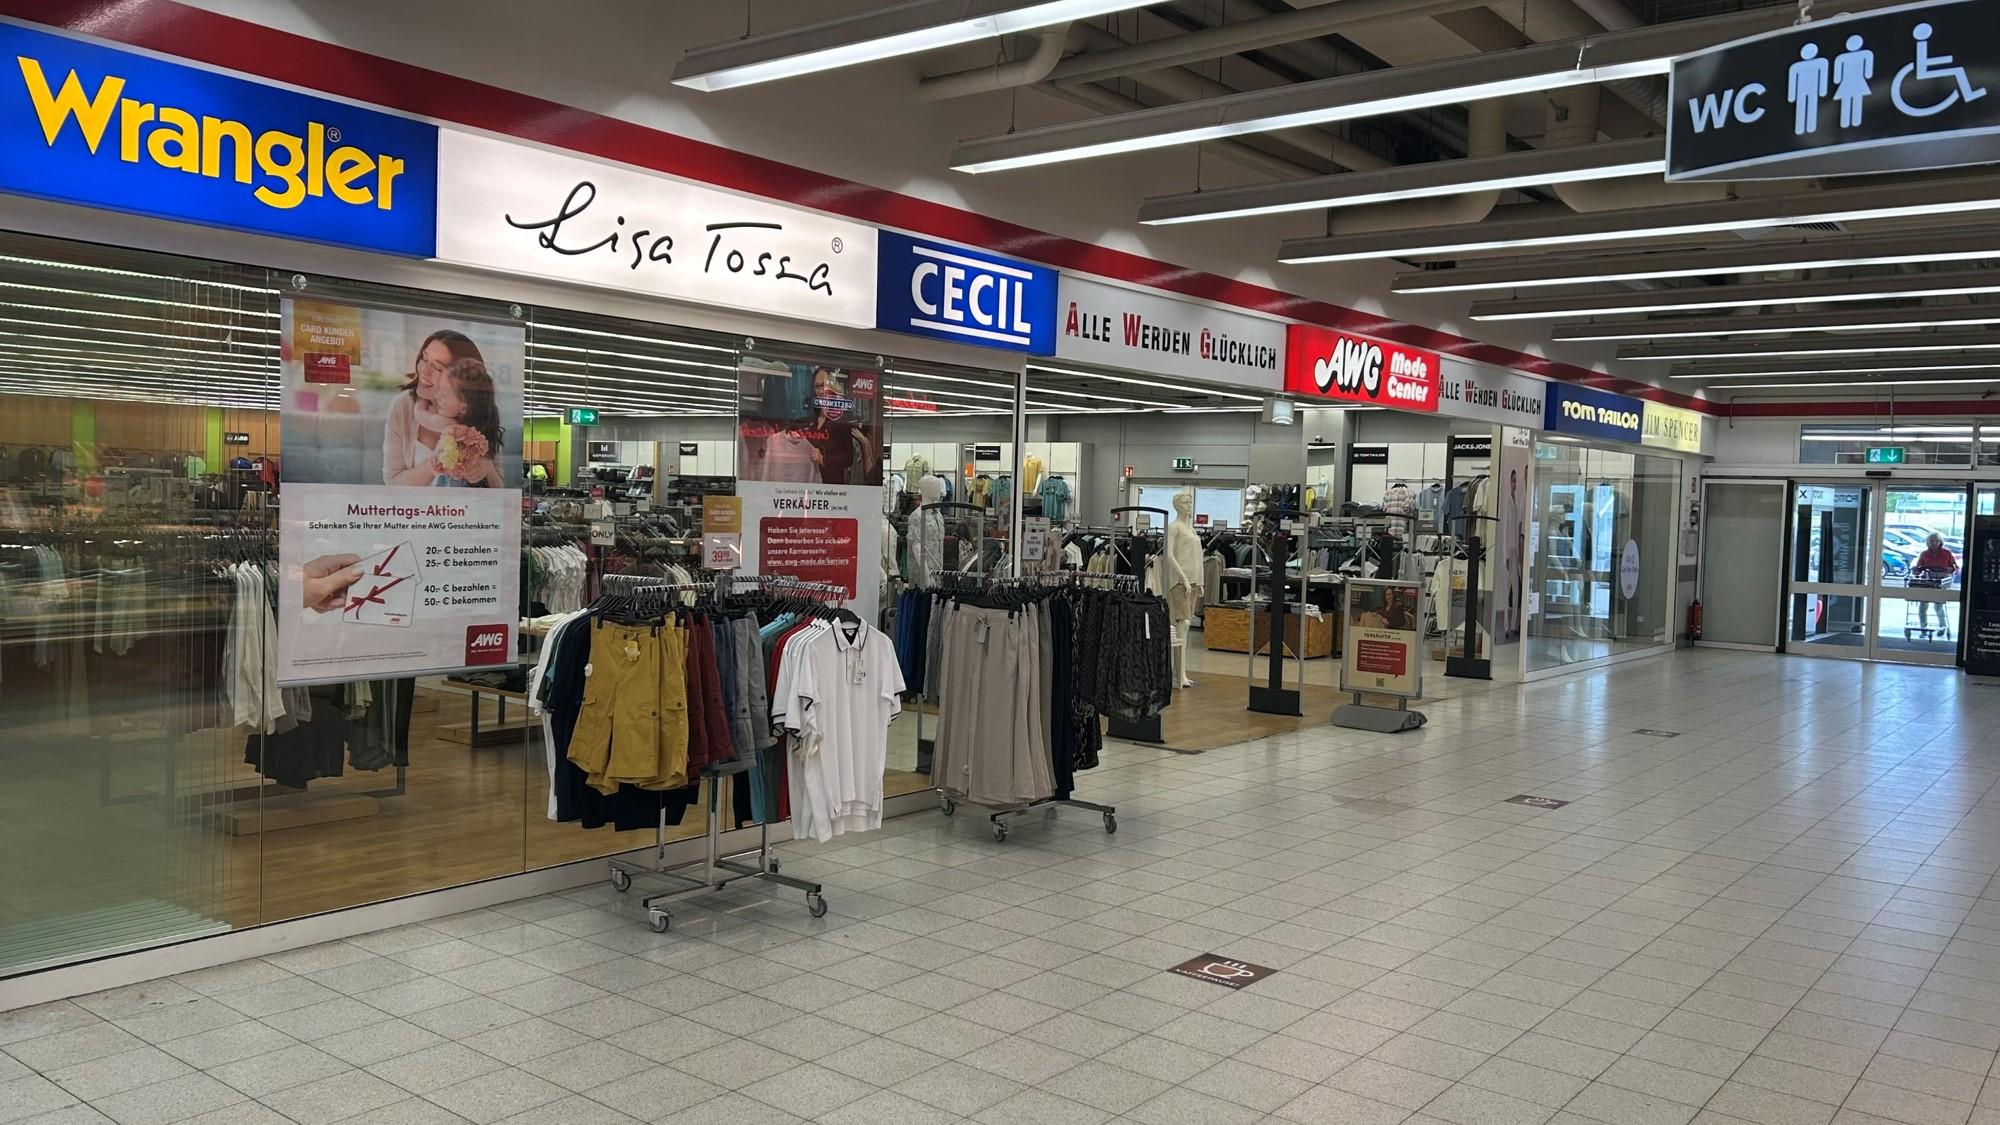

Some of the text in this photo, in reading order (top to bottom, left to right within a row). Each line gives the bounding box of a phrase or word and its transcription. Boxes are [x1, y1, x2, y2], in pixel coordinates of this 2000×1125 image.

[1688, 82, 1767, 133] WC
[17, 56, 405, 210] Wrangler
[505, 181, 833, 296] Lisa Tossa
[911, 262, 1031, 333] CECIL
[301, 324, 323, 335] CARD
[310, 334, 345, 346] ANGEBOT
[317, 356, 337, 365] AWG
[1314, 337, 1427, 393] AWG Mode
[852, 378, 874, 390] AWG
[1387, 375, 1428, 402] Center
[1562, 400, 1639, 431] TOM TAILOR
[1645, 414, 1699, 442] JIM SPENCER
[773, 497, 829, 510] VERKÄUFER
[309, 521, 348, 529] Schenken
[349, 521, 361, 529] Sie
[428, 522, 446, 530] AWG
[767, 526, 788, 534] Haben
[591, 530, 614, 538] ONLY
[767, 537, 784, 545] Dann
[443, 545, 451, 554] €
[453, 545, 491, 554] bezahlen
[443, 558, 450, 567] €
[452, 558, 498, 567] bekommen
[442, 583, 450, 592] €
[452, 583, 490, 592] bezahlen
[442, 596, 450, 605] €
[452, 596, 497, 605] bekommen
[471, 632, 503, 647] AWG
